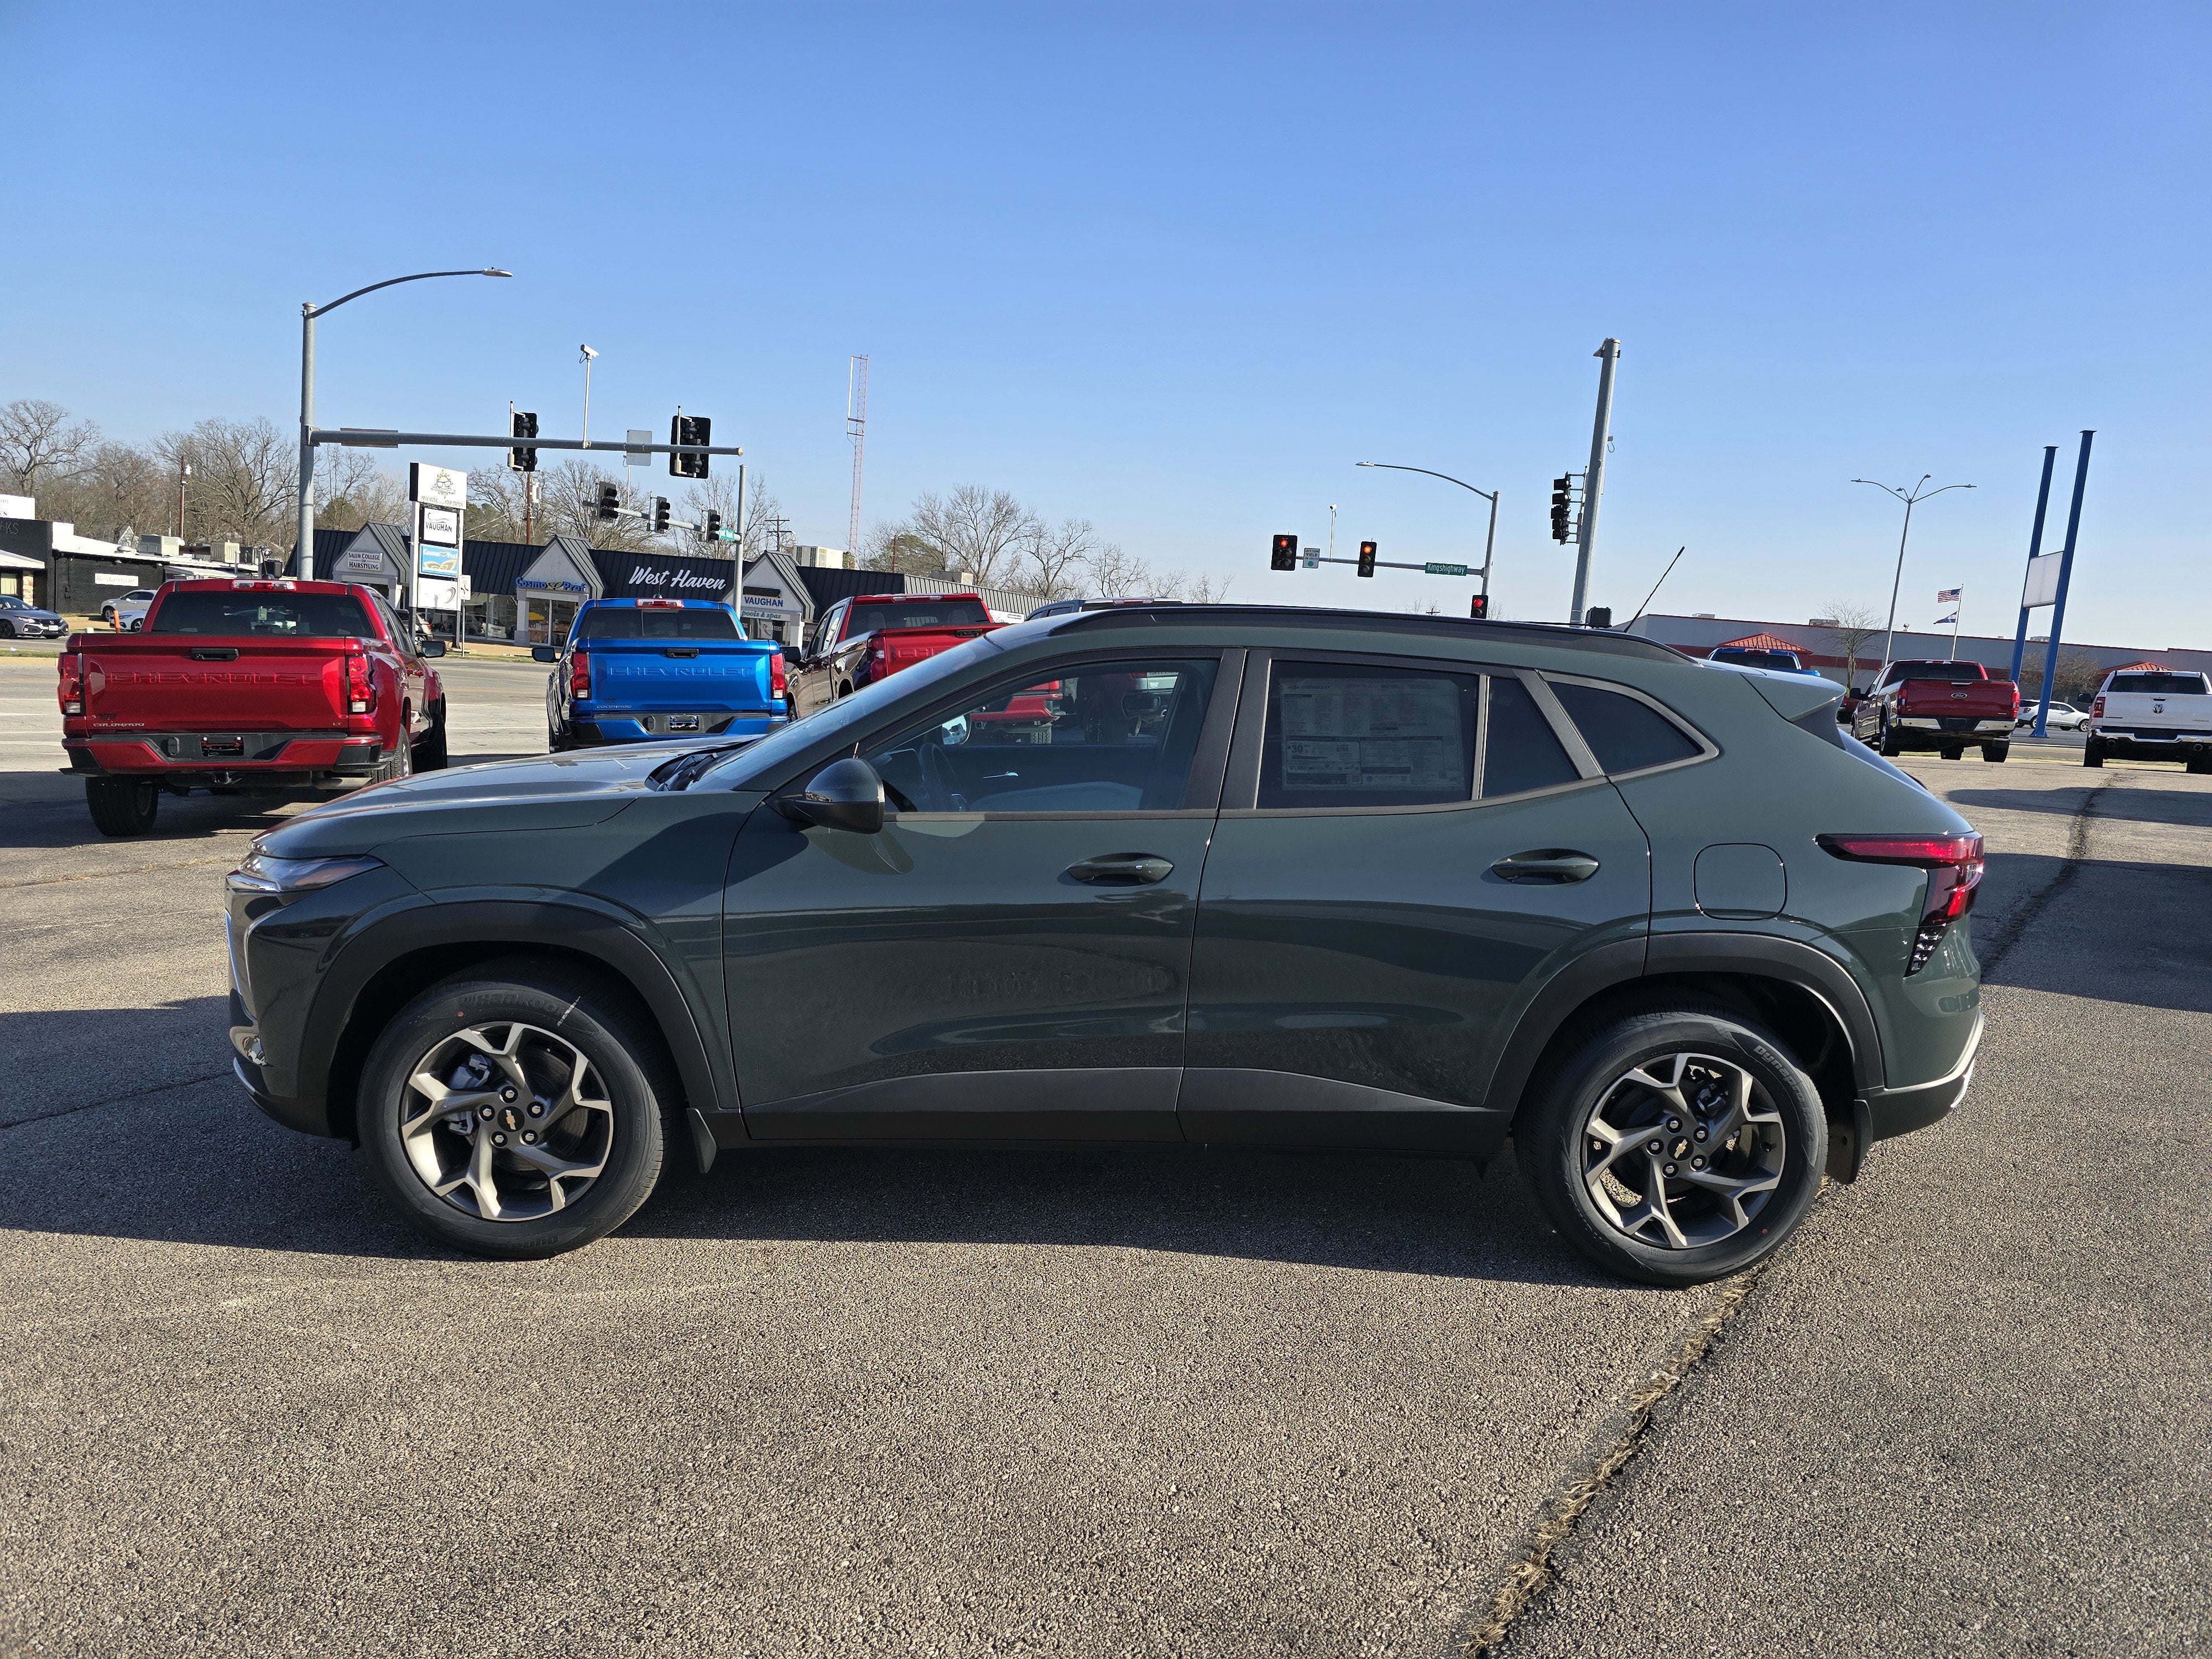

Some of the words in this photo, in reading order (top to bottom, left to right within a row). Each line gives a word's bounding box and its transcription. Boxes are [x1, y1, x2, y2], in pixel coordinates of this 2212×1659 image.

[426, 521, 452, 533] VAUGHAN
[423, 549, 440, 557] Cosmo
[1427, 564, 1465, 575] Kingshighway
[515, 576, 546, 589] Cosmo
[563, 581, 586, 592] Prof
[629, 566, 670, 585] West
[670, 569, 726, 590] Haven
[744, 596, 784, 607] VAUGHAN
[610, 666, 753, 677] CHEVROLET
[111, 672, 317, 684] CHEVROLET
[1753, 1045, 1806, 1102] Dynapro
